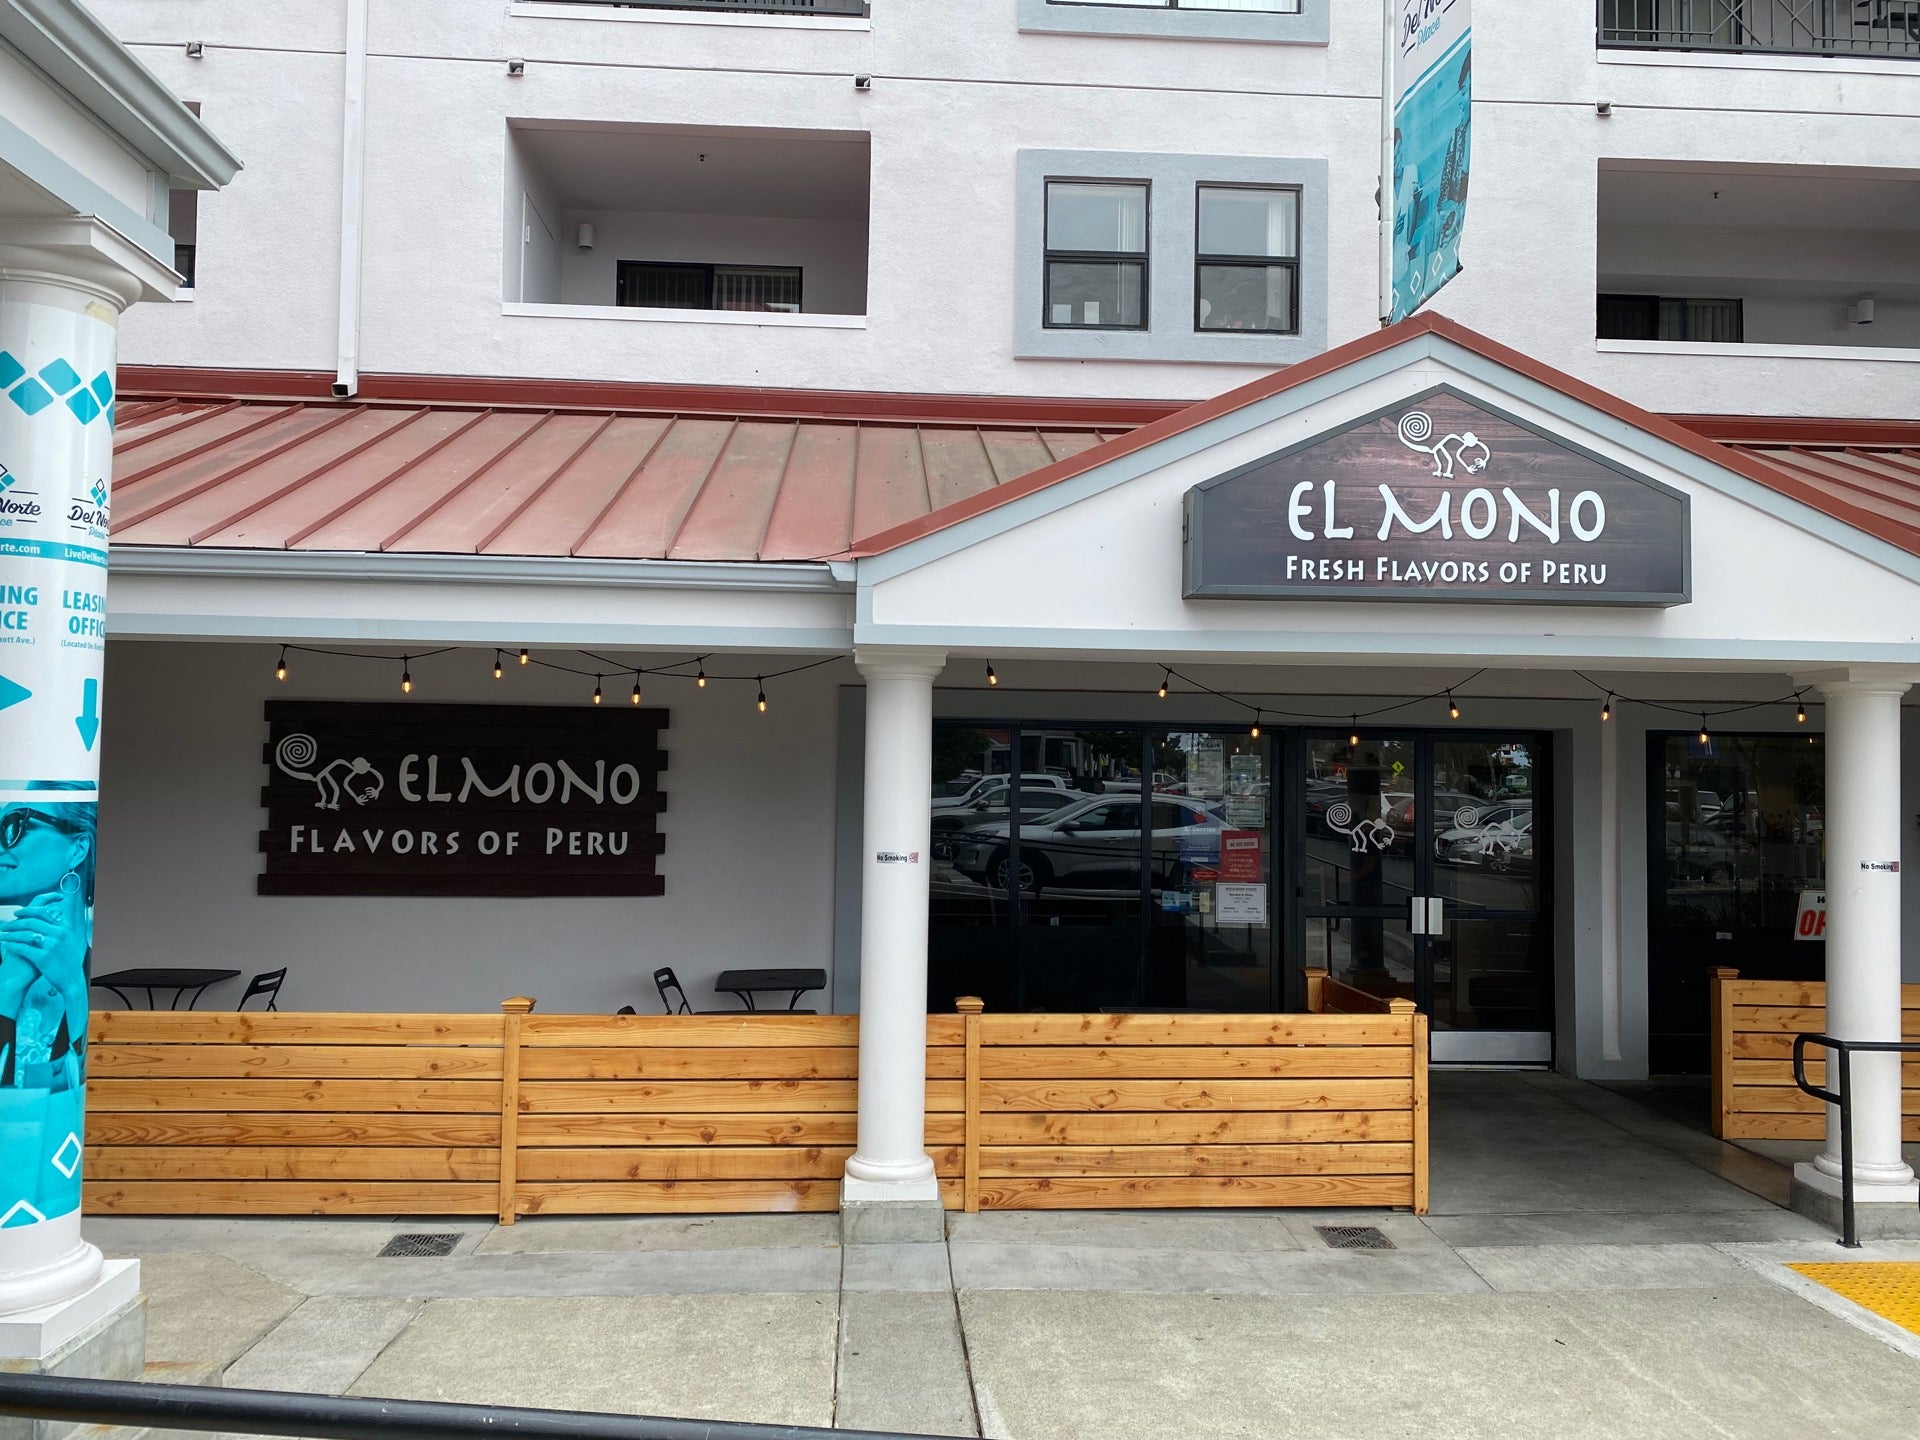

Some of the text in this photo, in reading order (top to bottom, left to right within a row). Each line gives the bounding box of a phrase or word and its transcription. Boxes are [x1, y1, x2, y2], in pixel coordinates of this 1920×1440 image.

[1417, 16, 1441, 50] Place
[67, 505, 94, 524] Del
[1288, 479, 1606, 545] EL MONO
[884, 854, 908, 862] Smoking
[1871, 863, 1894, 871] Smoking
